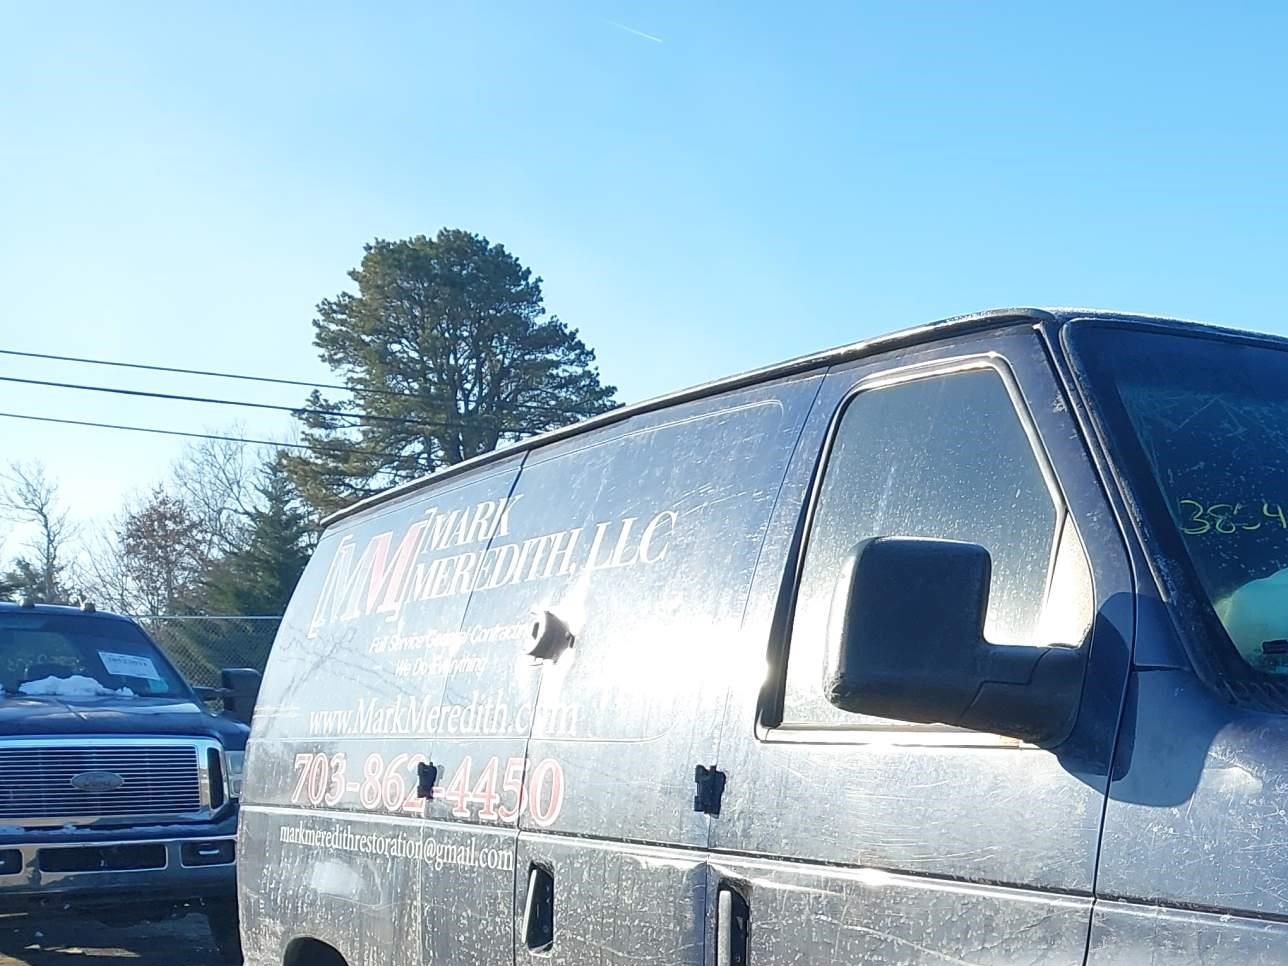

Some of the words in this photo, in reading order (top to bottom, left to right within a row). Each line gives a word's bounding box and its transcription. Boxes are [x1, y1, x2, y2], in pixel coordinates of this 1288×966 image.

[421, 494, 524, 553] MARK
[582, 510, 680, 571] LLC
[279, 823, 514, 872] markmeredithrestoration@gmail.com
